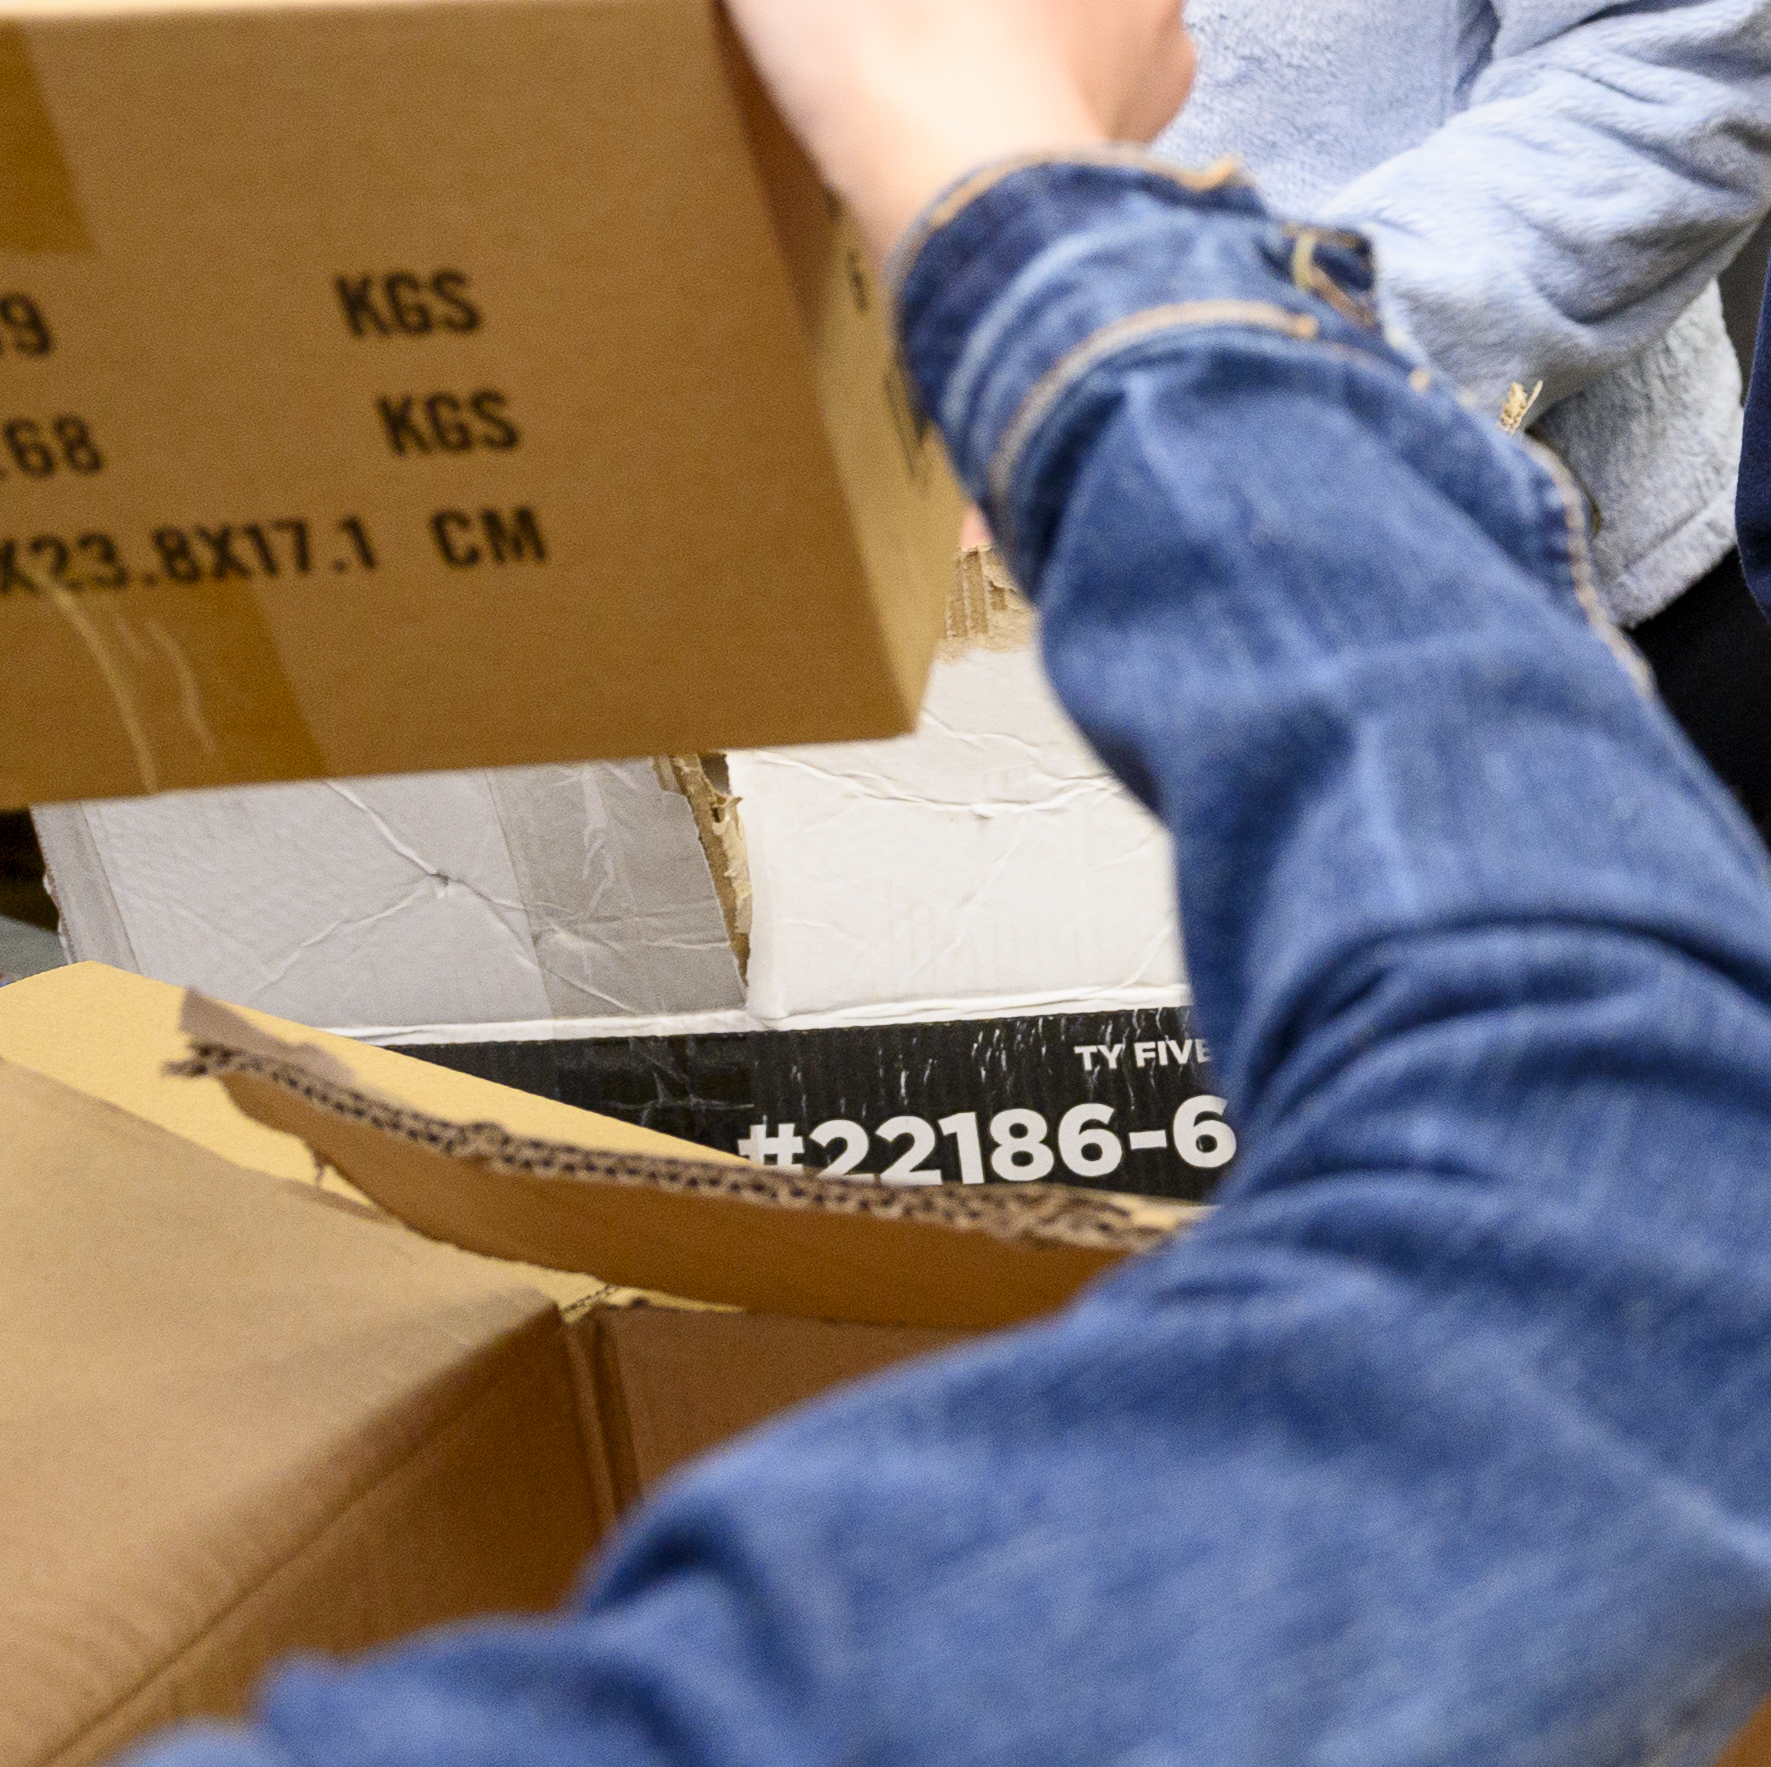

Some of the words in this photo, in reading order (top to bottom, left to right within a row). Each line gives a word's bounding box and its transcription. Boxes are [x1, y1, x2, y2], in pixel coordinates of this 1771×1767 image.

[334, 269, 484, 339] KGS
[376, 389, 522, 456] KGS
[430, 505, 549, 570] CM
[1075, 1045, 1122, 1071] TY
[1135, 1038, 1213, 1068] FIVE
[738, 1095, 1237, 1186] #22186-6
